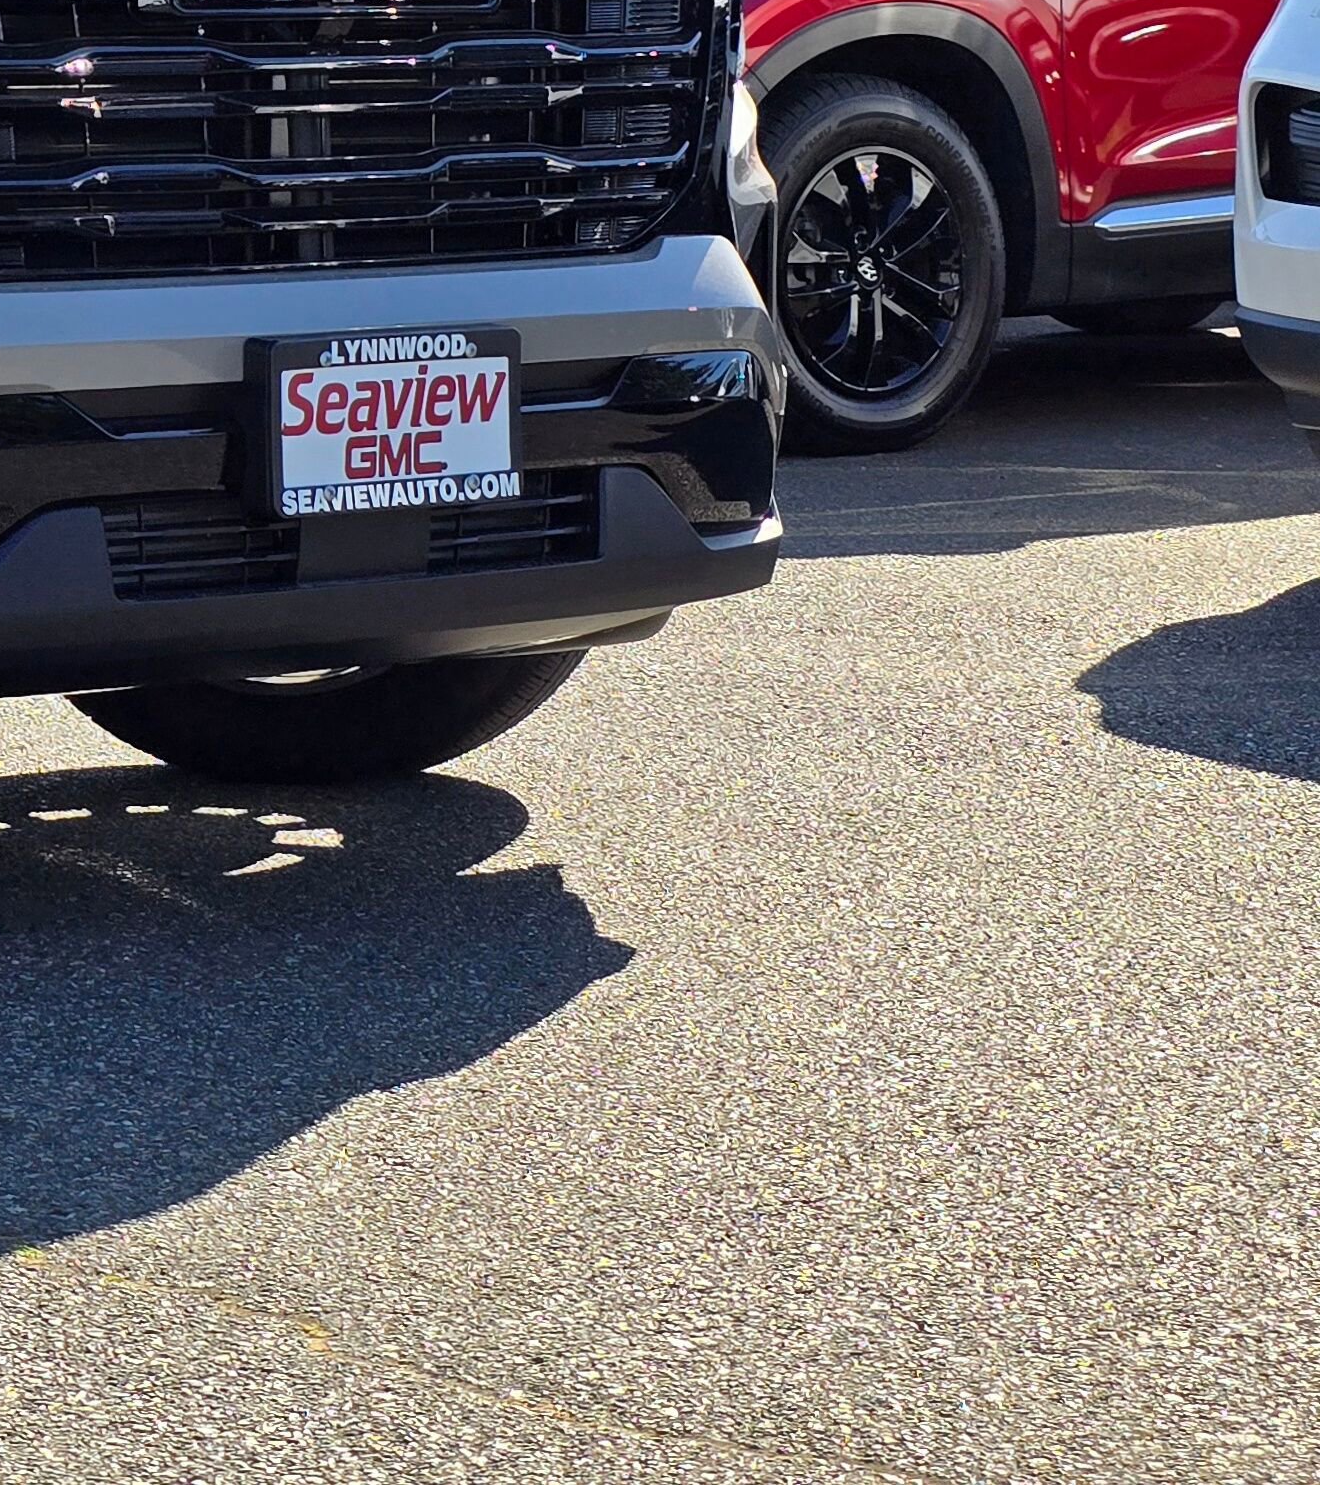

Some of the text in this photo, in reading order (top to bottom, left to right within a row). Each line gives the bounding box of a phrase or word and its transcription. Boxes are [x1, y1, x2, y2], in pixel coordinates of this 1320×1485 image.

[330, 333, 467, 365] LYNNWOOD
[280, 365, 507, 437] Seaview
[344, 431, 443, 480] GMC
[281, 471, 521, 516] SEAVIEWAUTO.COM
